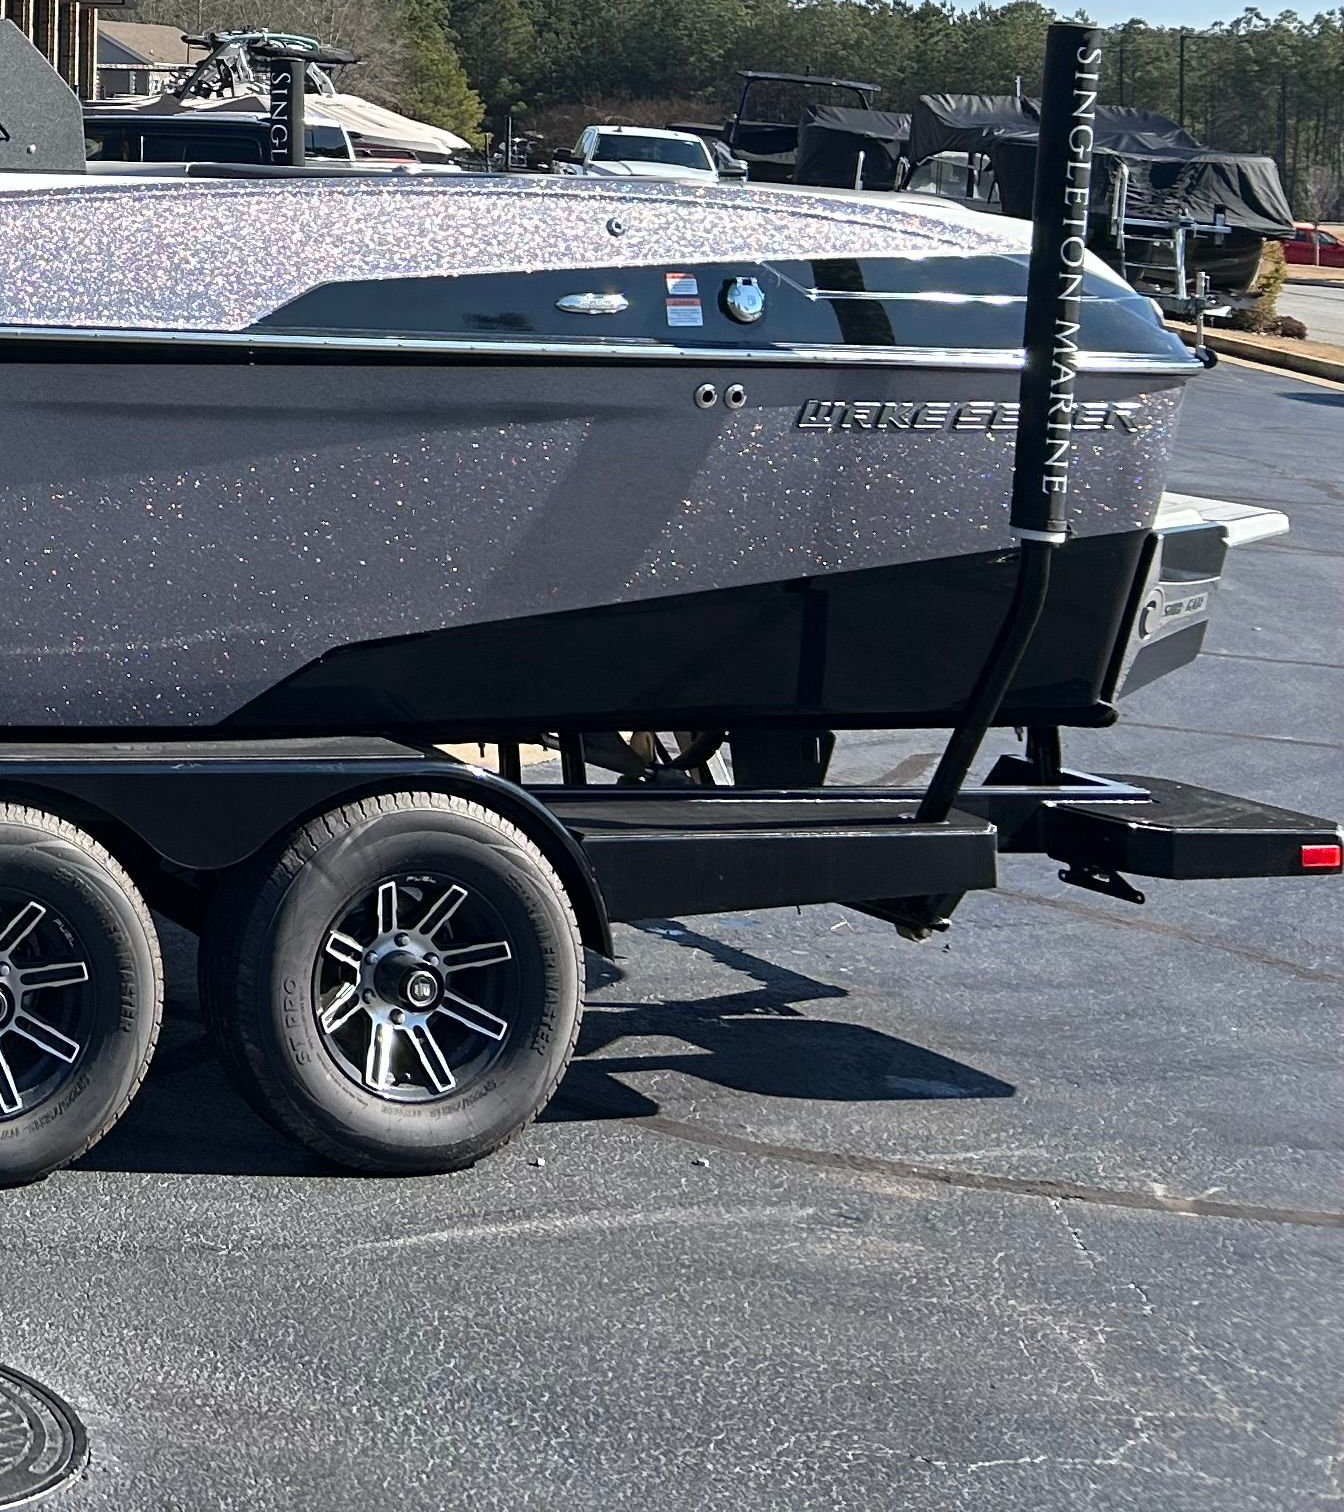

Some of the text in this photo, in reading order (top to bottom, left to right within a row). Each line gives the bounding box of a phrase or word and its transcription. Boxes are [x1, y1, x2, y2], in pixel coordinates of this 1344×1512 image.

[1056, 45, 1102, 303] SINGLETON
[798, 399, 1143, 433] WAKESEER
[1042, 317, 1081, 495] MARINE
[283, 978, 303, 1029] PRO
